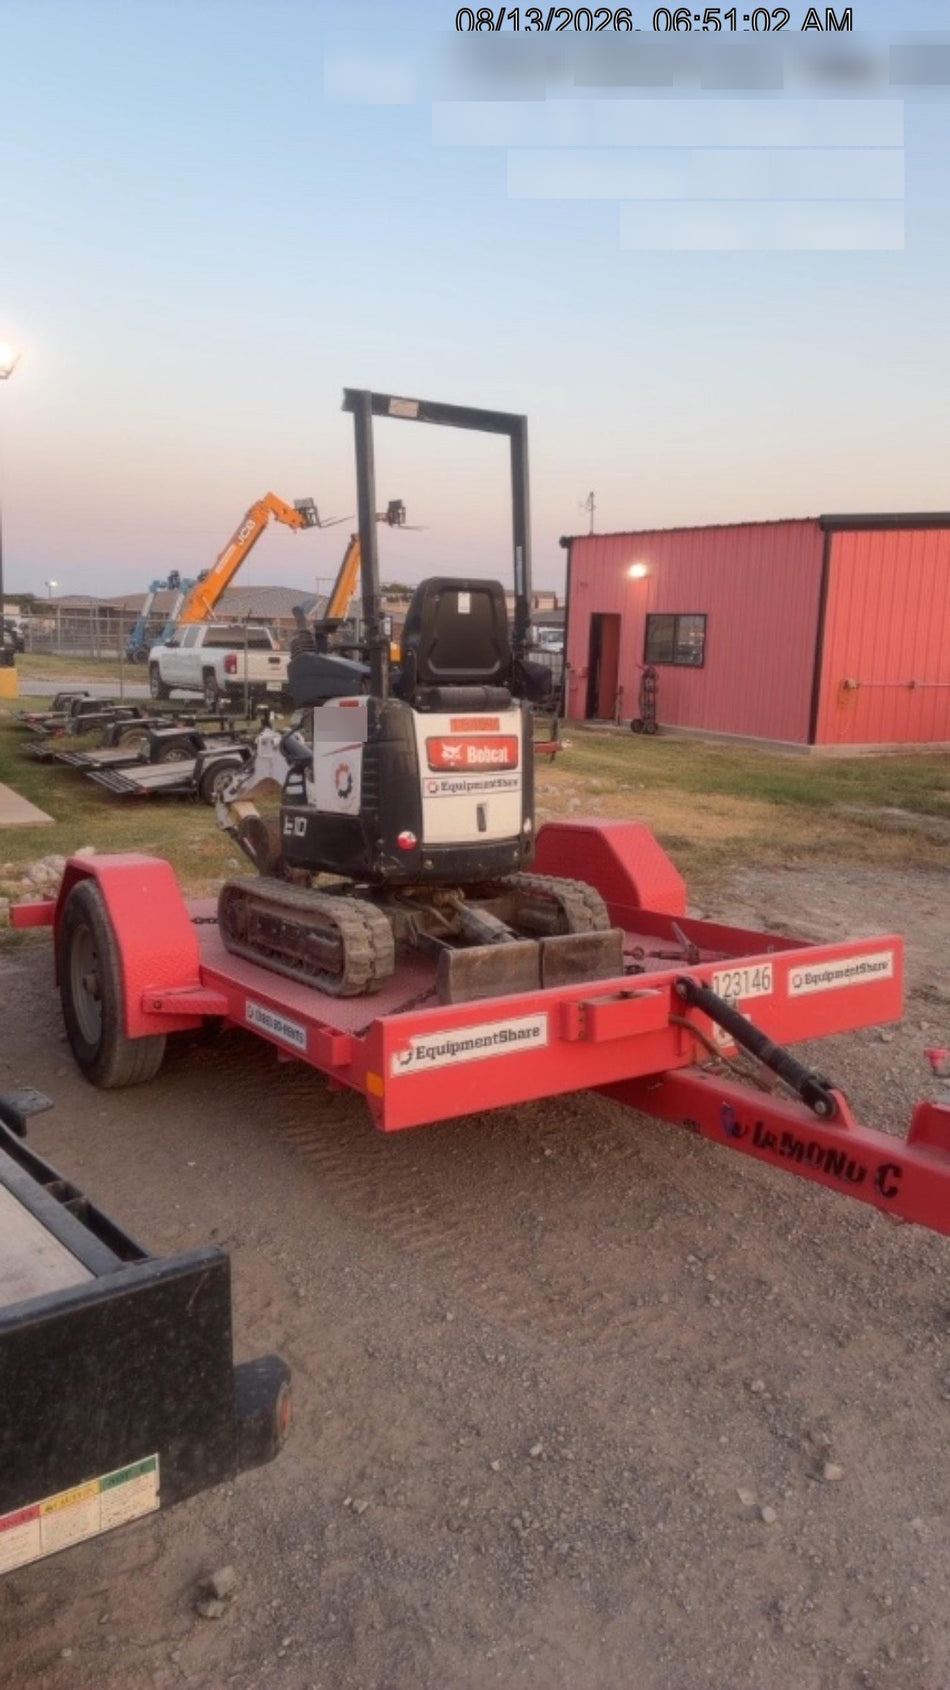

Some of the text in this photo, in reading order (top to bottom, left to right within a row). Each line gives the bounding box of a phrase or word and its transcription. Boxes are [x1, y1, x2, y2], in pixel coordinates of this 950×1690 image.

[238, 519, 256, 546] JCB
[467, 745, 508, 763] Bobcat
[440, 779, 518, 793] EquipmentShare
[714, 966, 771, 999] 123146
[804, 961, 889, 987] EquipmentShare
[416, 1025, 541, 1061] EquipmentShare
